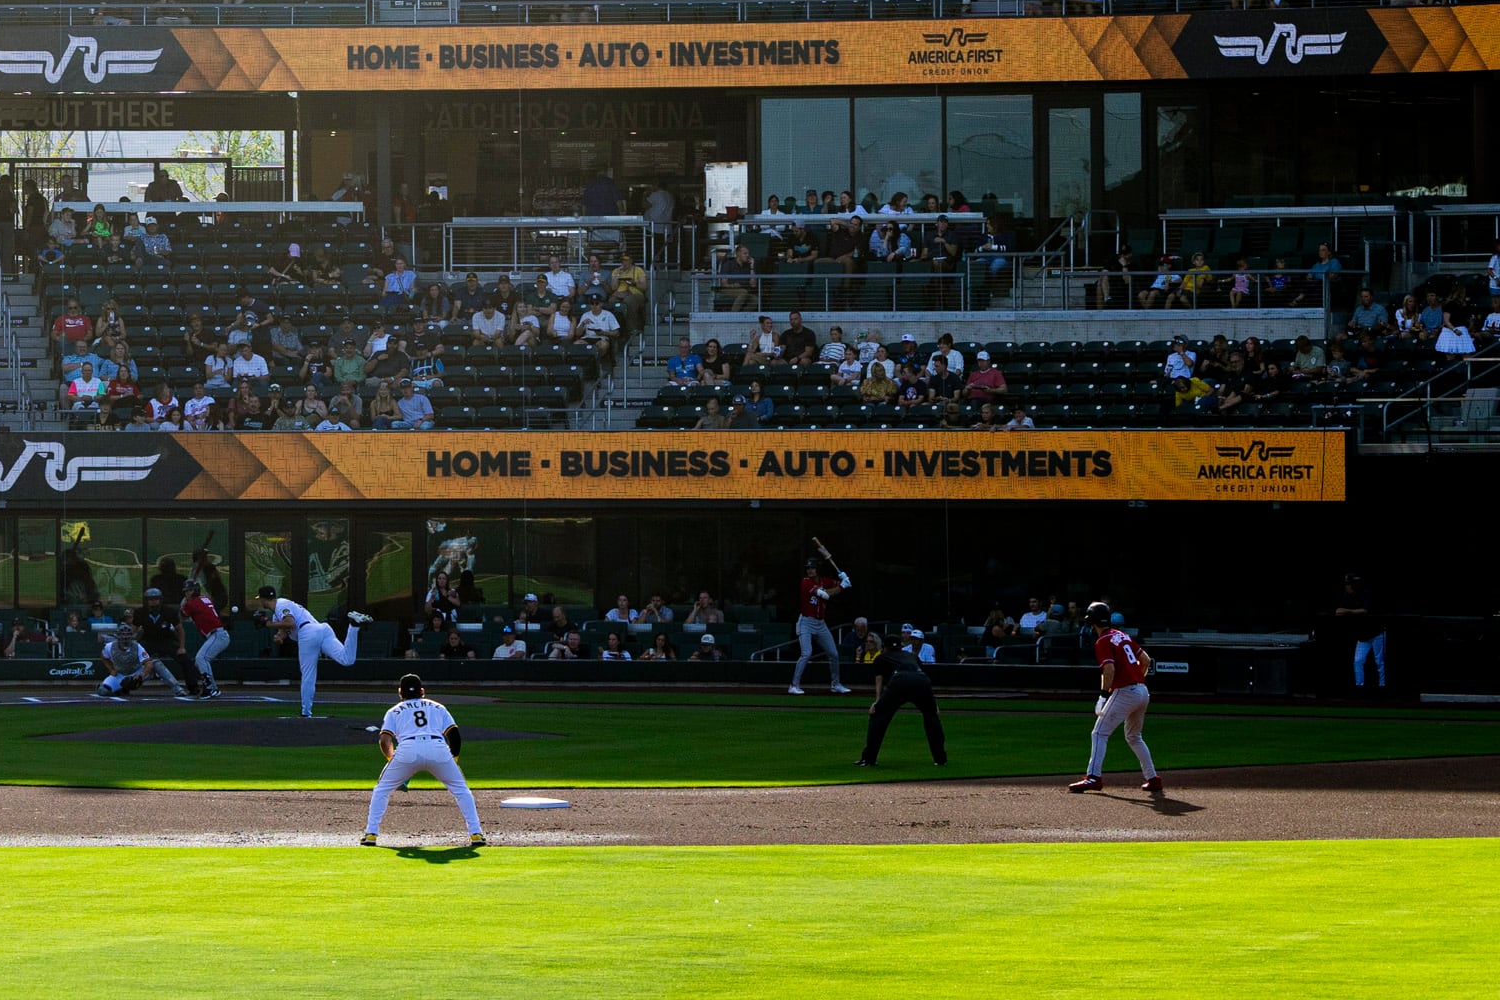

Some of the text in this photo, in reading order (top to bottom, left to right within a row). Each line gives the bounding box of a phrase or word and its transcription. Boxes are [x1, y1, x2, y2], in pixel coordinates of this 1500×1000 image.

[347, 39, 840, 70] HOME BUSINESS AUTO INVESTMENTS
[908, 49, 1003, 65] AMERICA FIRST
[922, 67, 989, 76] CREDIT UNION
[90, 101, 174, 127] THERE
[581, 101, 704, 129] CANTINA
[427, 449, 1113, 478] HOME BUSINESS AUTO INVESTMENTS
[1197, 465, 1314, 479] AMERICA FIRST
[1215, 485, 1296, 493] CREDIT UNION
[1123, 644, 1137, 664] 8
[413, 710, 428, 727] 8
